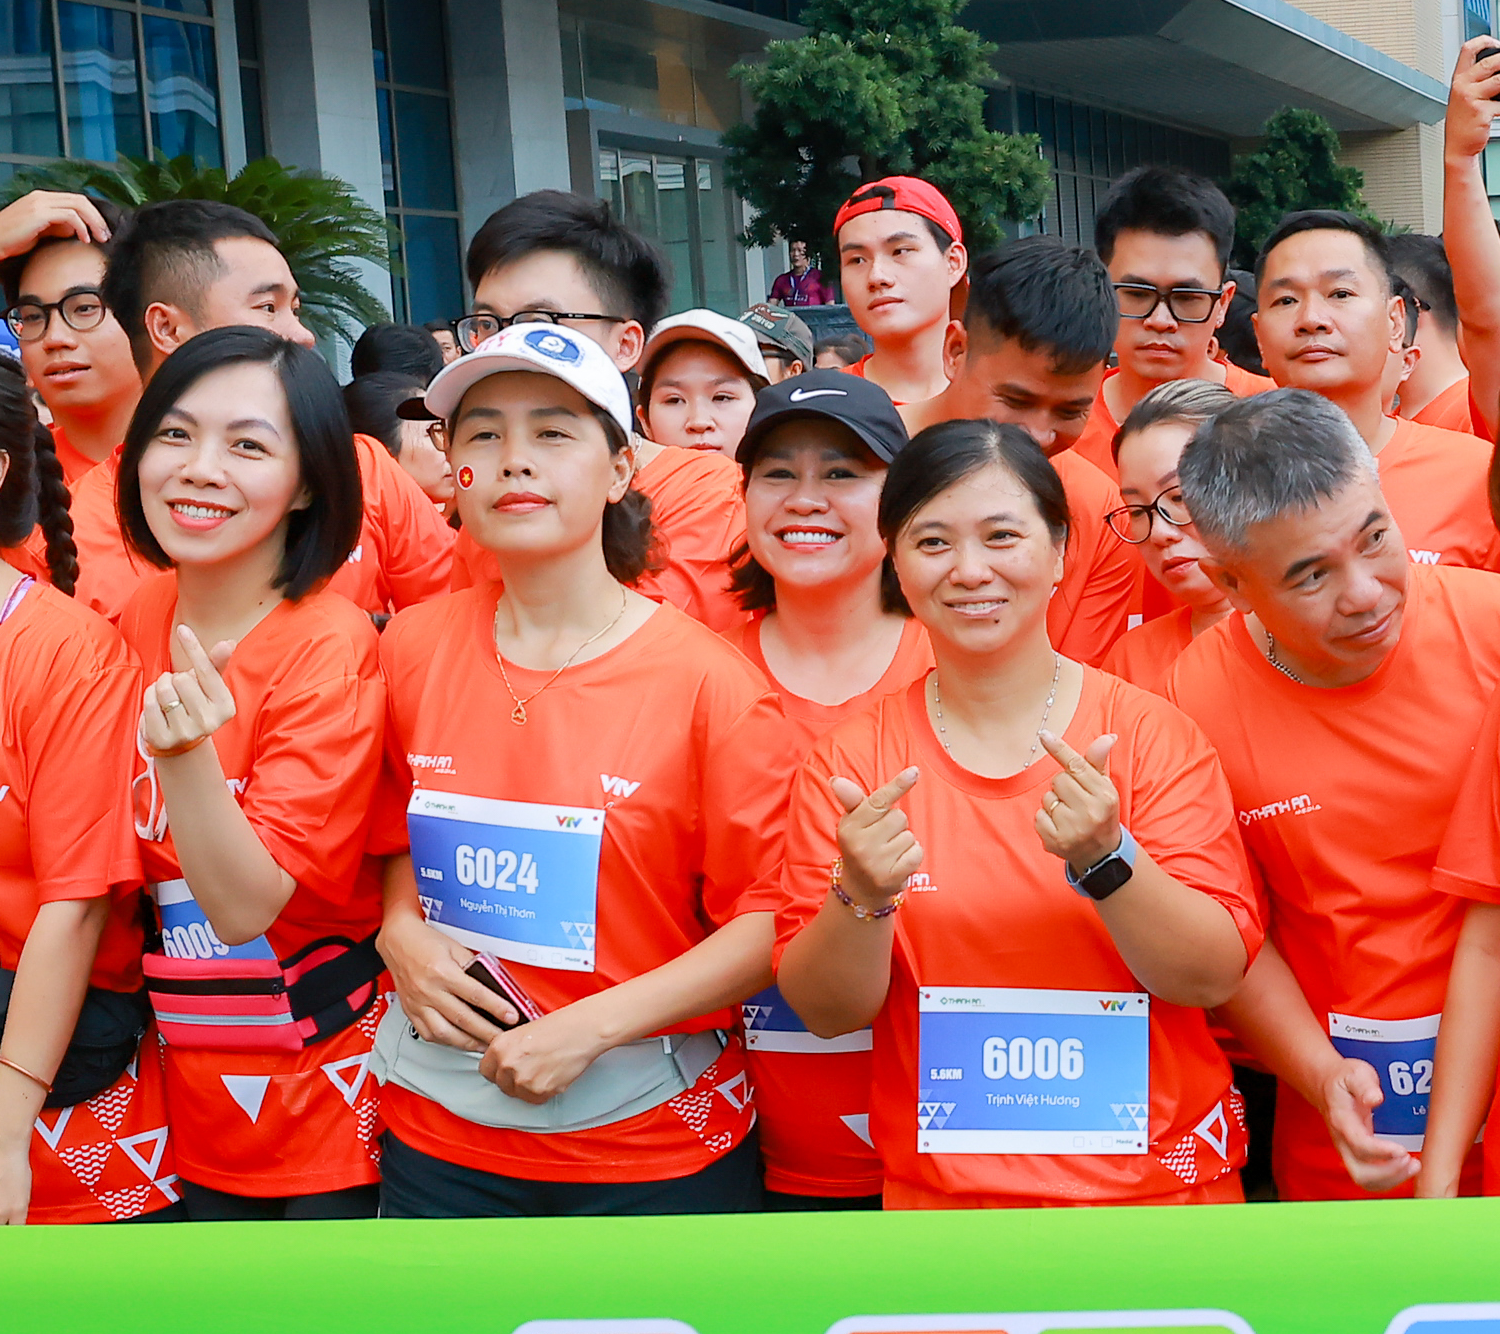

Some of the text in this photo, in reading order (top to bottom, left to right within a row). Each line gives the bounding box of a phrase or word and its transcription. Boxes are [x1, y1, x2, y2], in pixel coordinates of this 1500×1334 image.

[1408, 549, 1443, 566] VTV
[600, 774, 643, 799] VTV
[1249, 794, 1312, 821] THANH AN
[556, 815, 584, 828] VTV
[455, 844, 540, 895] 6024
[912, 873, 930, 887] AN
[1098, 999, 1128, 1012] VTV
[982, 1035, 1085, 1081] 6006
[930, 1068, 963, 1081] 5.6KM
[1388, 1059, 1434, 1096] 62
[986, 1093, 1080, 1109] Trịnh Việt Hương
